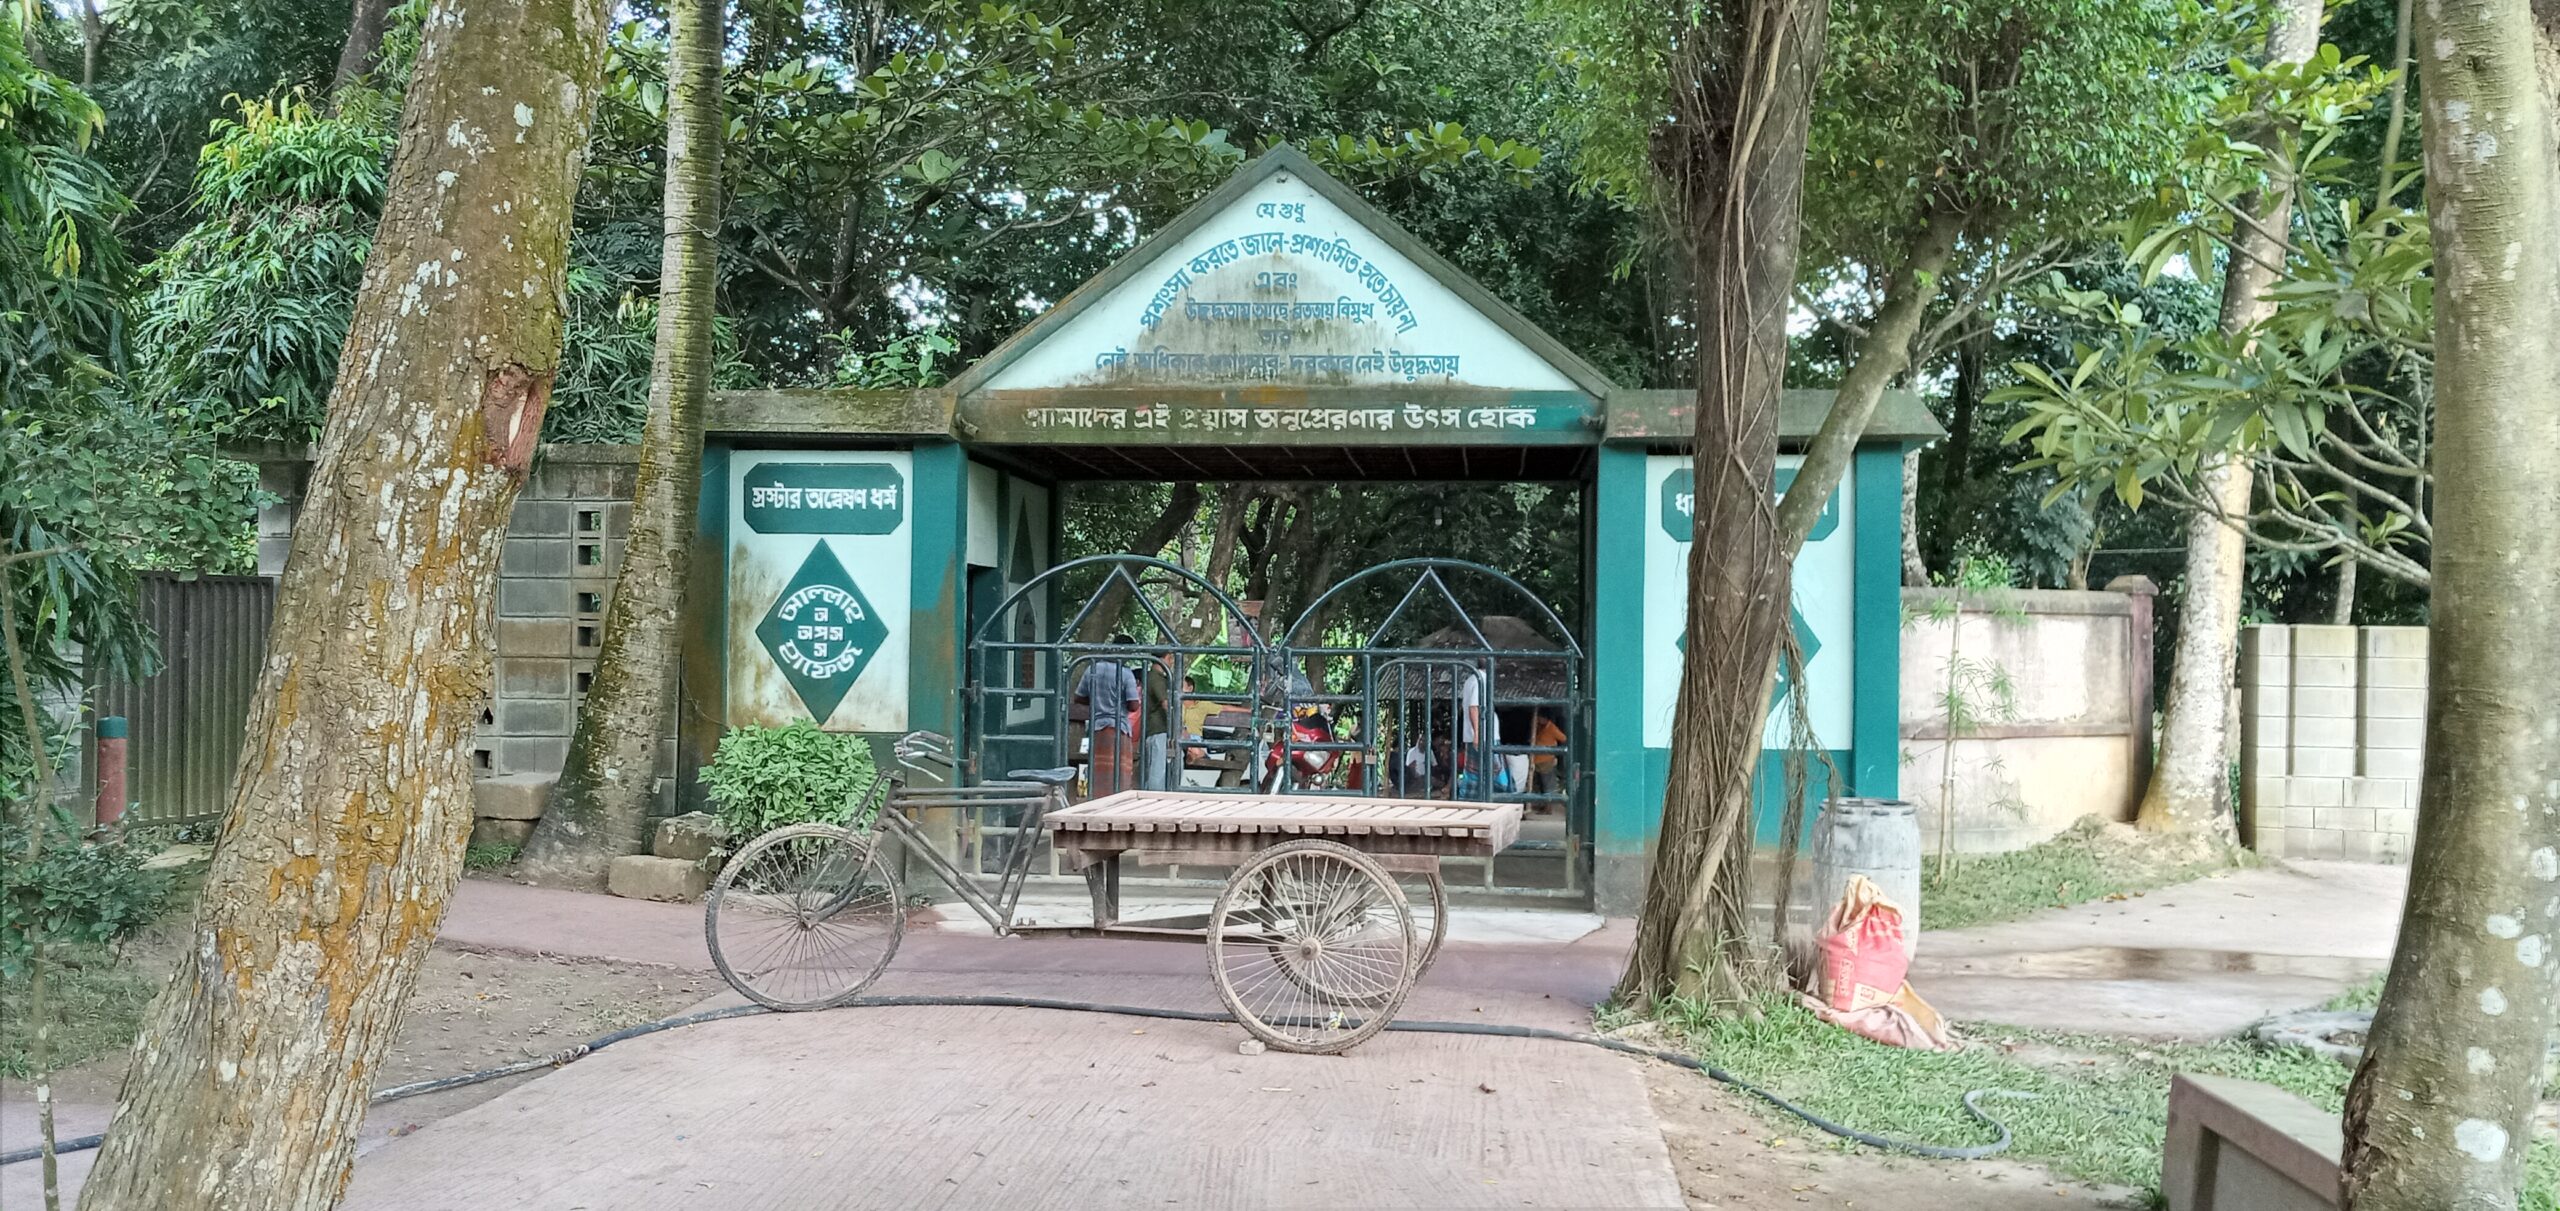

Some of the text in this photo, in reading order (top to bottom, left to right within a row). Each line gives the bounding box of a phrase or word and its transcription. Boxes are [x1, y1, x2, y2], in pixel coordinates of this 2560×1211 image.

[1257, 203, 1306, 223] যে শুধু
[1186, 239, 1239, 275] করতে
[1358, 261, 1388, 294] হতে
[1378, 284, 1409, 318] চায়
[1396, 310, 1418, 335] না
[1255, 272, 1298, 290] এবং
[1337, 296, 1374, 323] বিমুখ
[1096, 345, 1129, 370] নেই
[1356, 347, 1384, 373] নেই
[1388, 347, 1460, 381] উদ্বুদ্ধতায়
[1022, 407, 1127, 430] আমাদের
[1133, 402, 1170, 430] এই
[1254, 408, 1395, 431] অনুপ্রেরণার
[1403, 402, 1461, 429] উৎস
[1467, 405, 1537, 429] হোক
[805, 487, 867, 510] অন্বেষণ
[870, 484, 897, 510] ধর্ম
[814, 607, 829, 622] অ
[813, 642, 828, 658] স
